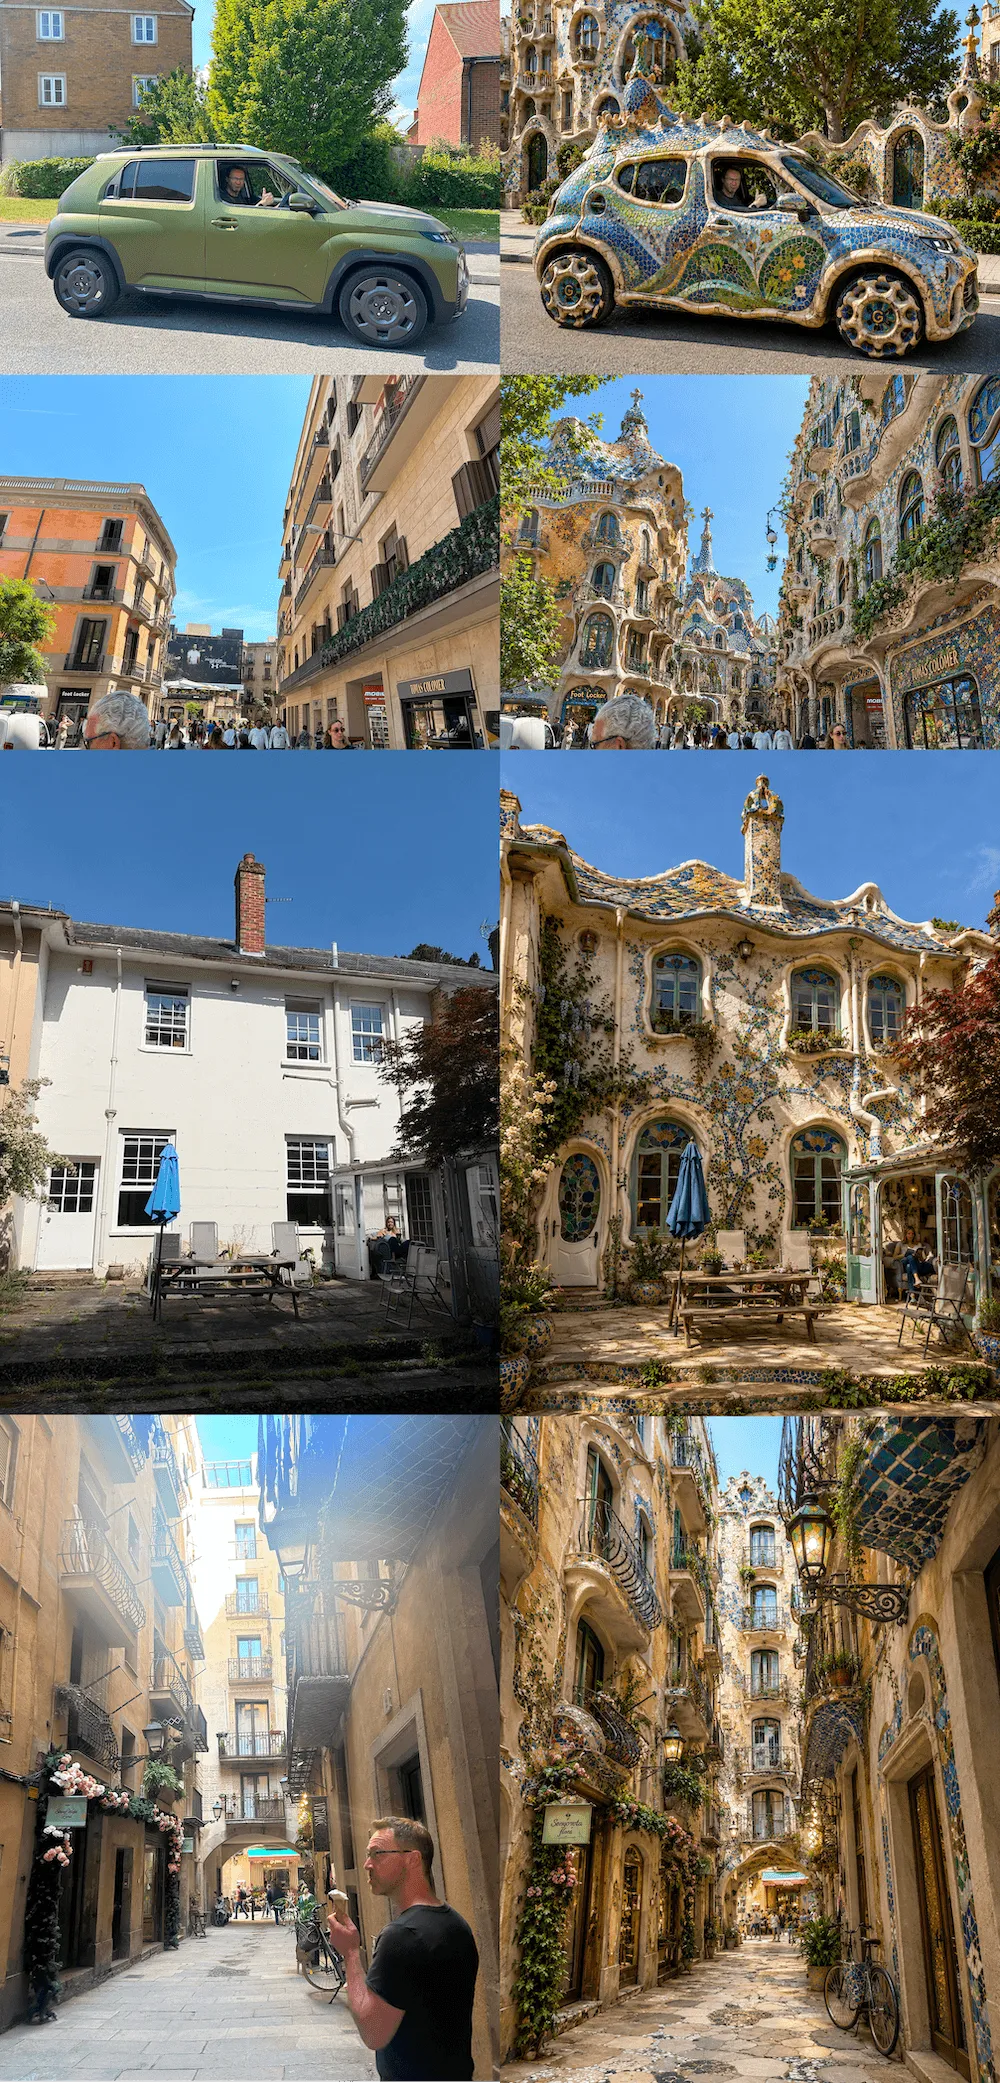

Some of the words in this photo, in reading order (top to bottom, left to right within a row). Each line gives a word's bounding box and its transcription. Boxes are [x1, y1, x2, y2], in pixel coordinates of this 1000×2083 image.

[872, 309, 884, 323] G
[570, 690, 584, 698] Foot
[586, 690, 606, 699] Locker
